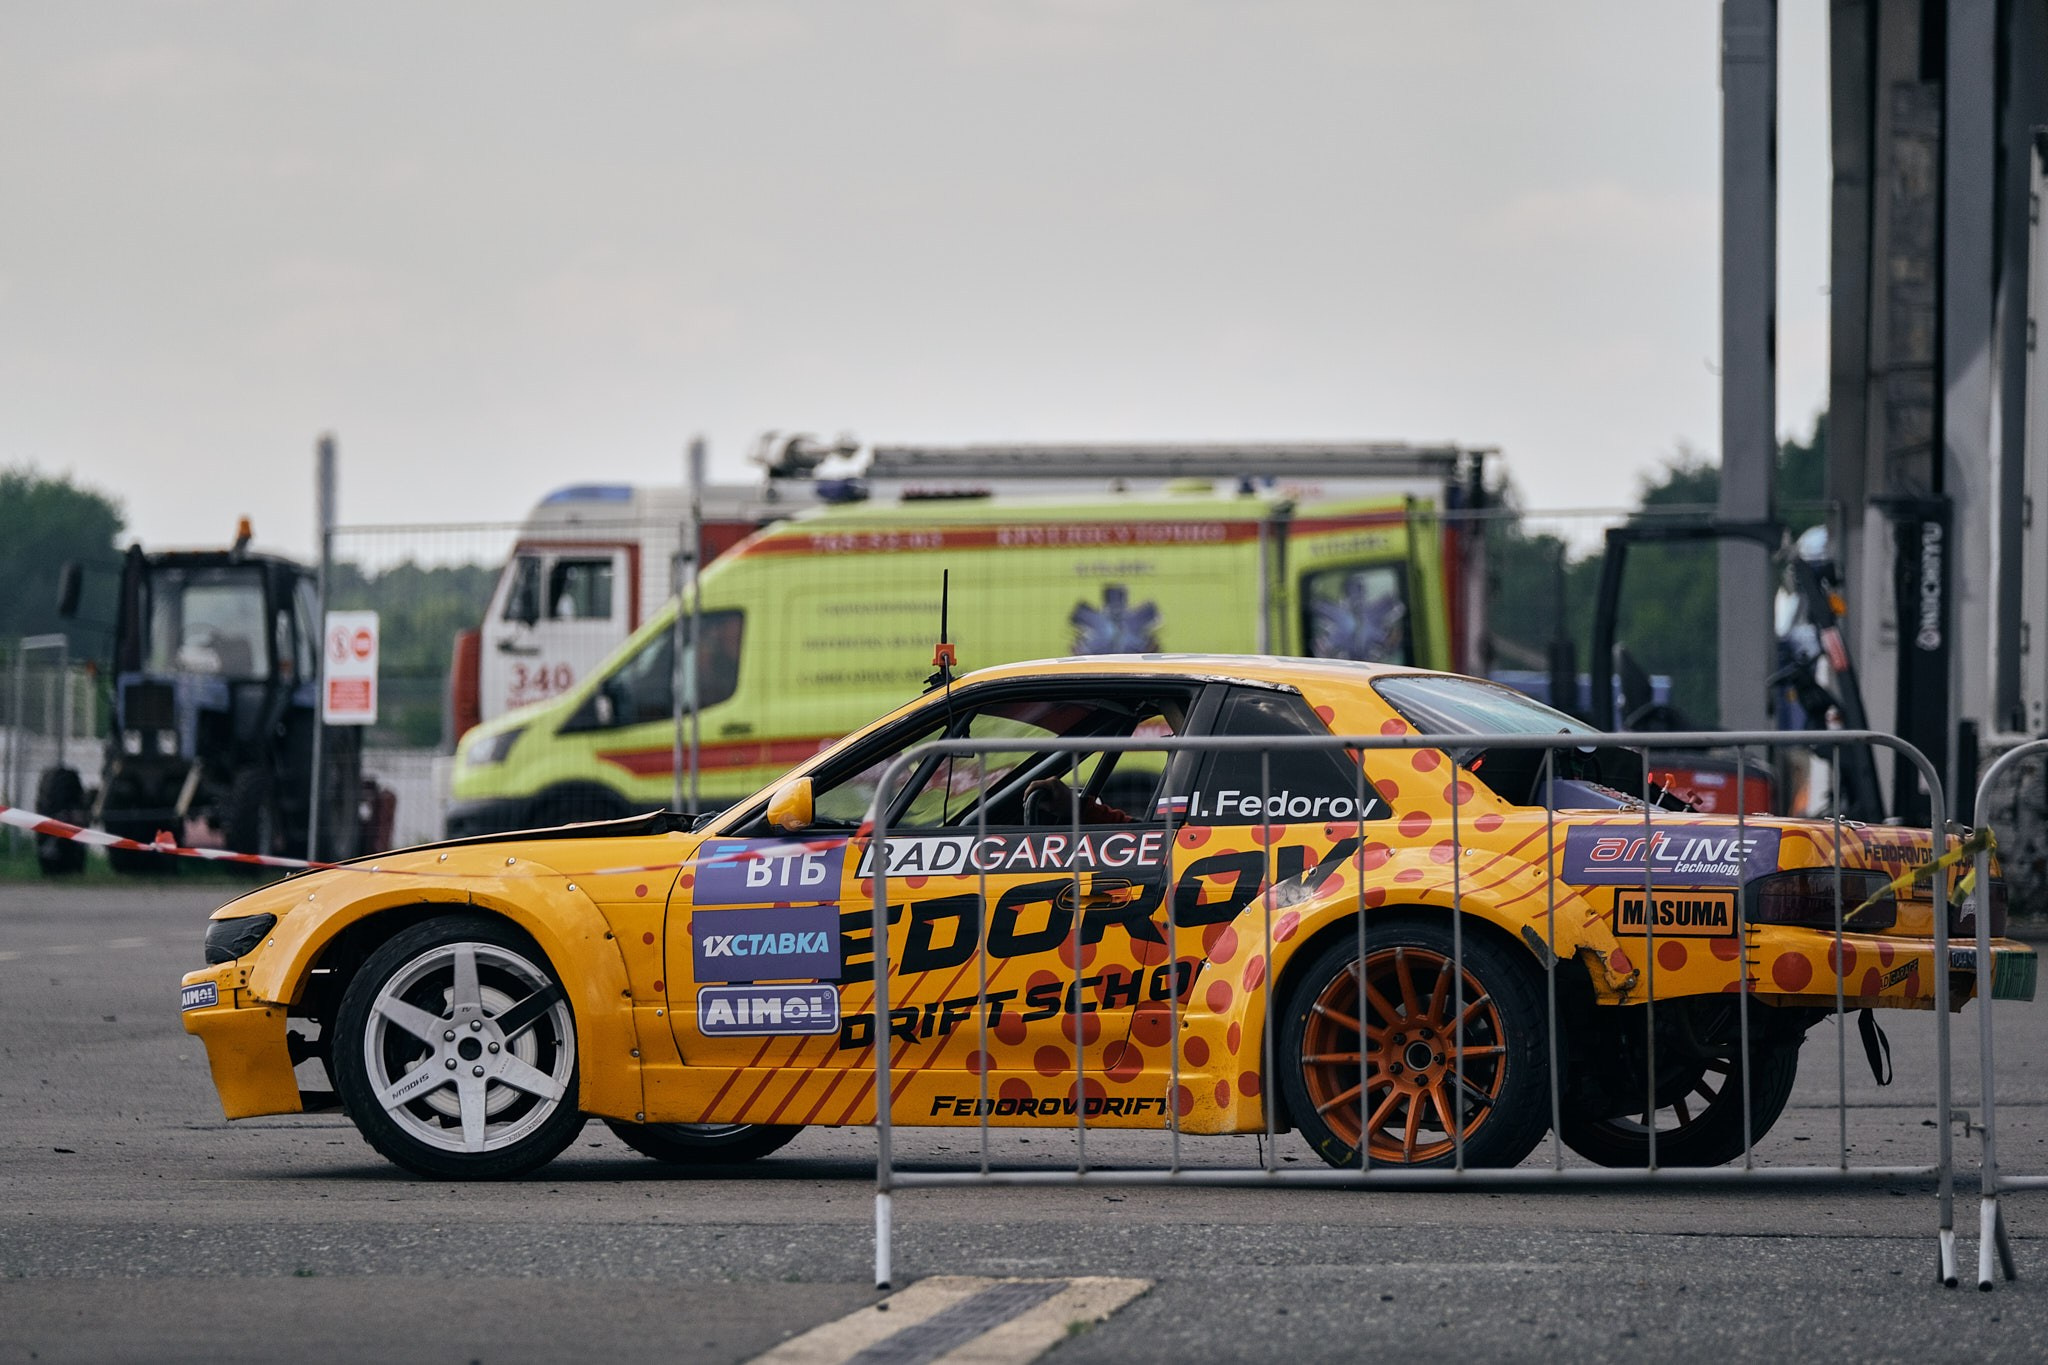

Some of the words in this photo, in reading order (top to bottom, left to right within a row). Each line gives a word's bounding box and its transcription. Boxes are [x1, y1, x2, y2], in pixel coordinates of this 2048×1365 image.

[508, 662, 575, 693] 340
[746, 850, 827, 888] ВТБ
[1674, 861, 1740, 876] technology
[838, 836, 1367, 985] EDOROV
[1622, 900, 1727, 926] MASUMA
[182, 988, 215, 1006] AIMOL
[705, 997, 831, 1025] AIMOL
[840, 989, 1018, 1050] DRIFT
[1022, 957, 1207, 1022] SCHO
